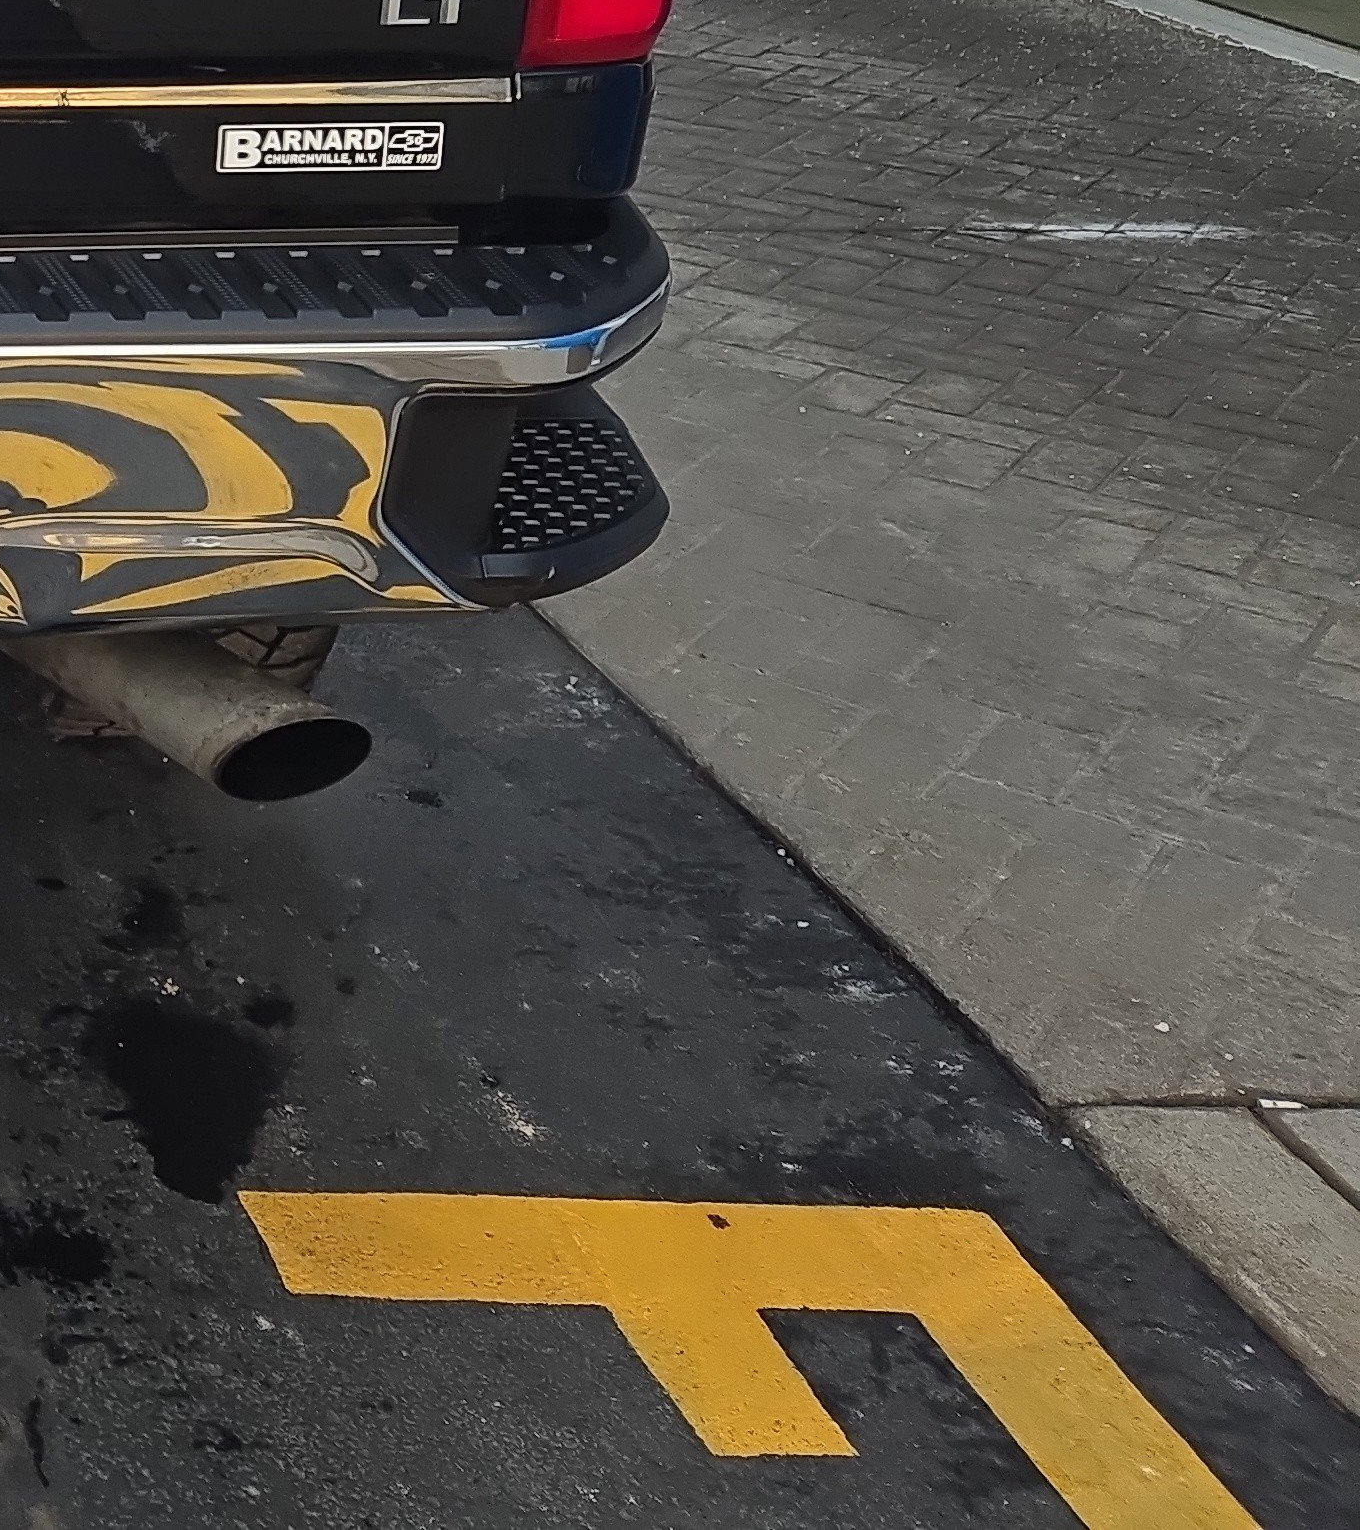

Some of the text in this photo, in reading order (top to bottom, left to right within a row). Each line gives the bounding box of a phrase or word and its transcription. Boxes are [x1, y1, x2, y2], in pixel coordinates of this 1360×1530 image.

[223, 128, 384, 168] BARNARD
[264, 152, 378, 165] CHURCHVILLE, N.Y.
[386, 153, 415, 165] SINCE
